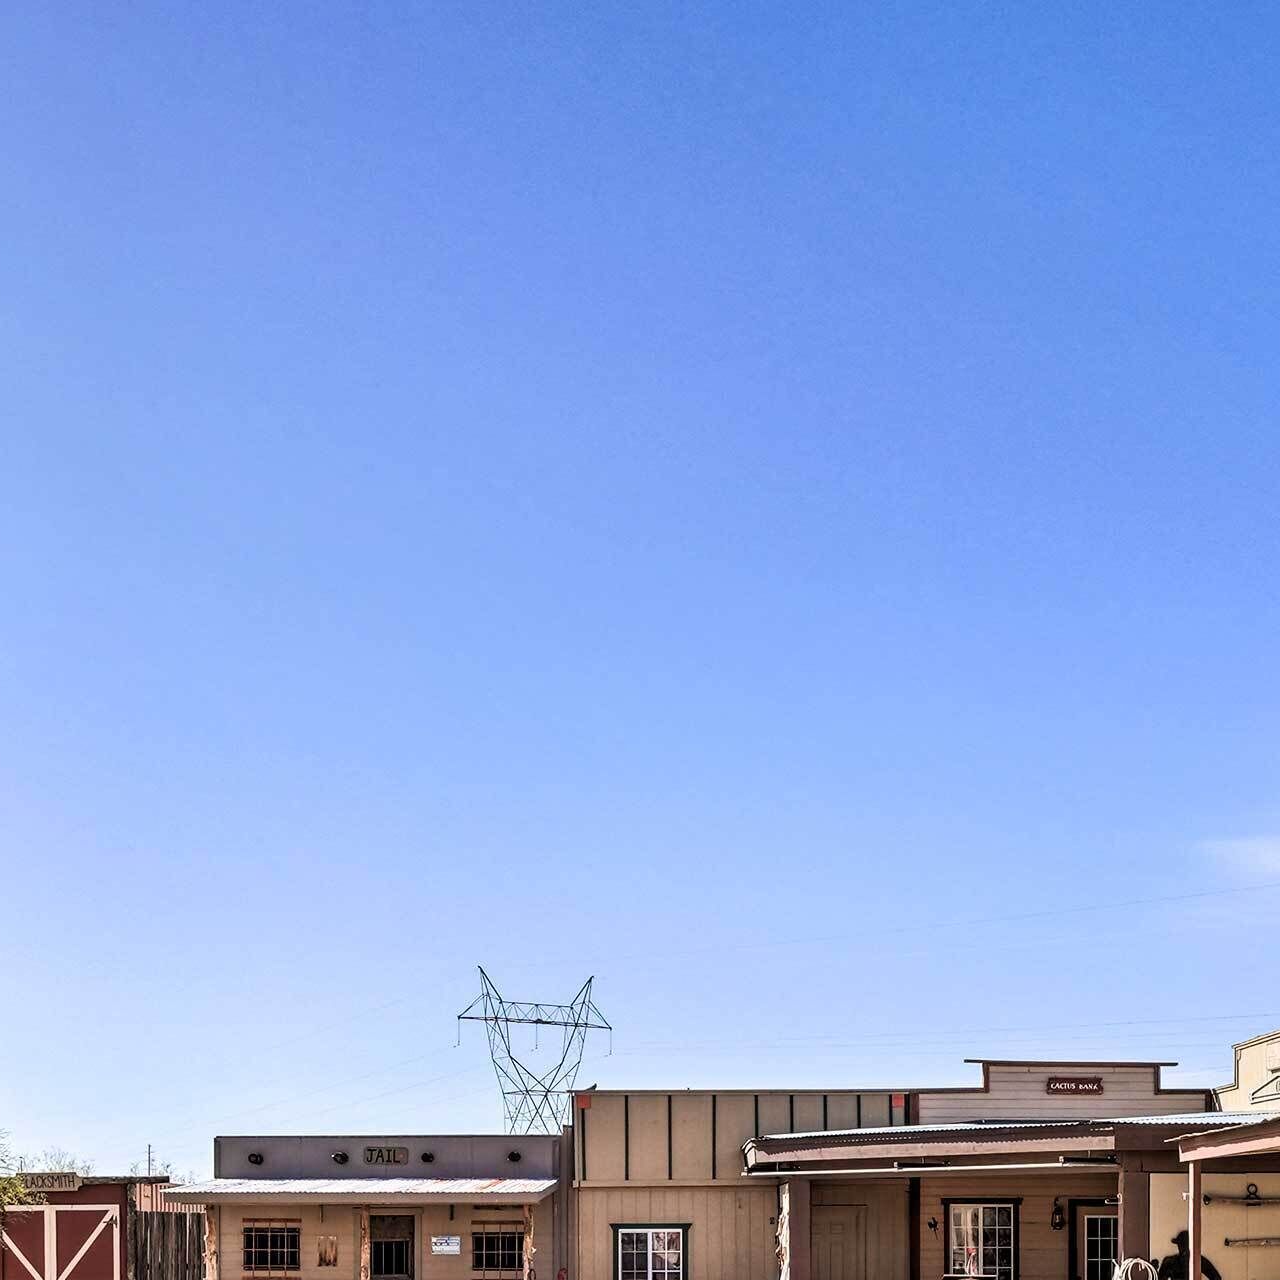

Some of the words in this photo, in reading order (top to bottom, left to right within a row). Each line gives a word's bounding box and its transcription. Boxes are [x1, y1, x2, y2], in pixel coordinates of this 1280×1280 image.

[1050, 1082, 1076, 1090] CACTUS
[366, 1148, 401, 1163] JAIL
[20, 1174, 75, 1189] LACKSMITH
